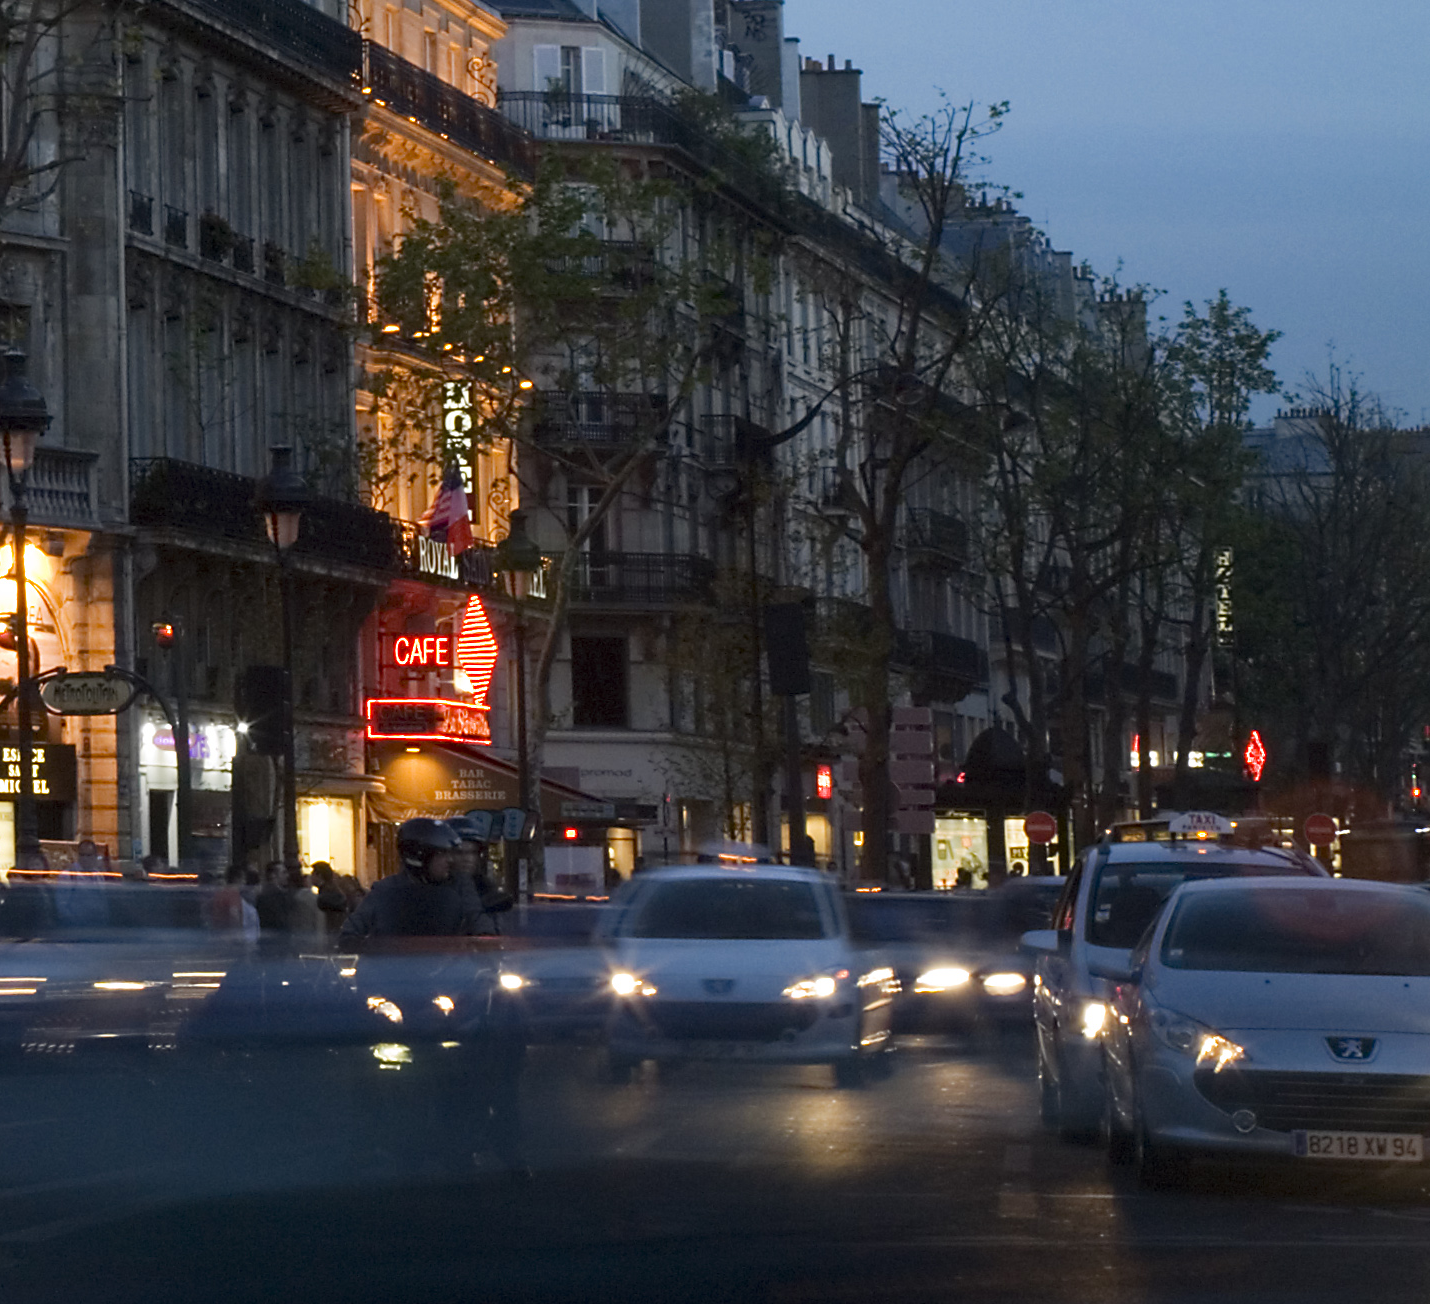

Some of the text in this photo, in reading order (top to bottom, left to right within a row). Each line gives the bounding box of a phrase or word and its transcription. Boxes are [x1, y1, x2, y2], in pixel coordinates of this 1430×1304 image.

[418, 535, 459, 580] ROYAL
[394, 636, 450, 666] CAFE
[459, 768, 485, 778] BAR
[450, 779, 491, 790] TABAC
[434, 790, 506, 801] BRASSERIE
[1189, 814, 1216, 825] TAXI
[1309, 1135, 1417, 1157] 8218 XW 94
